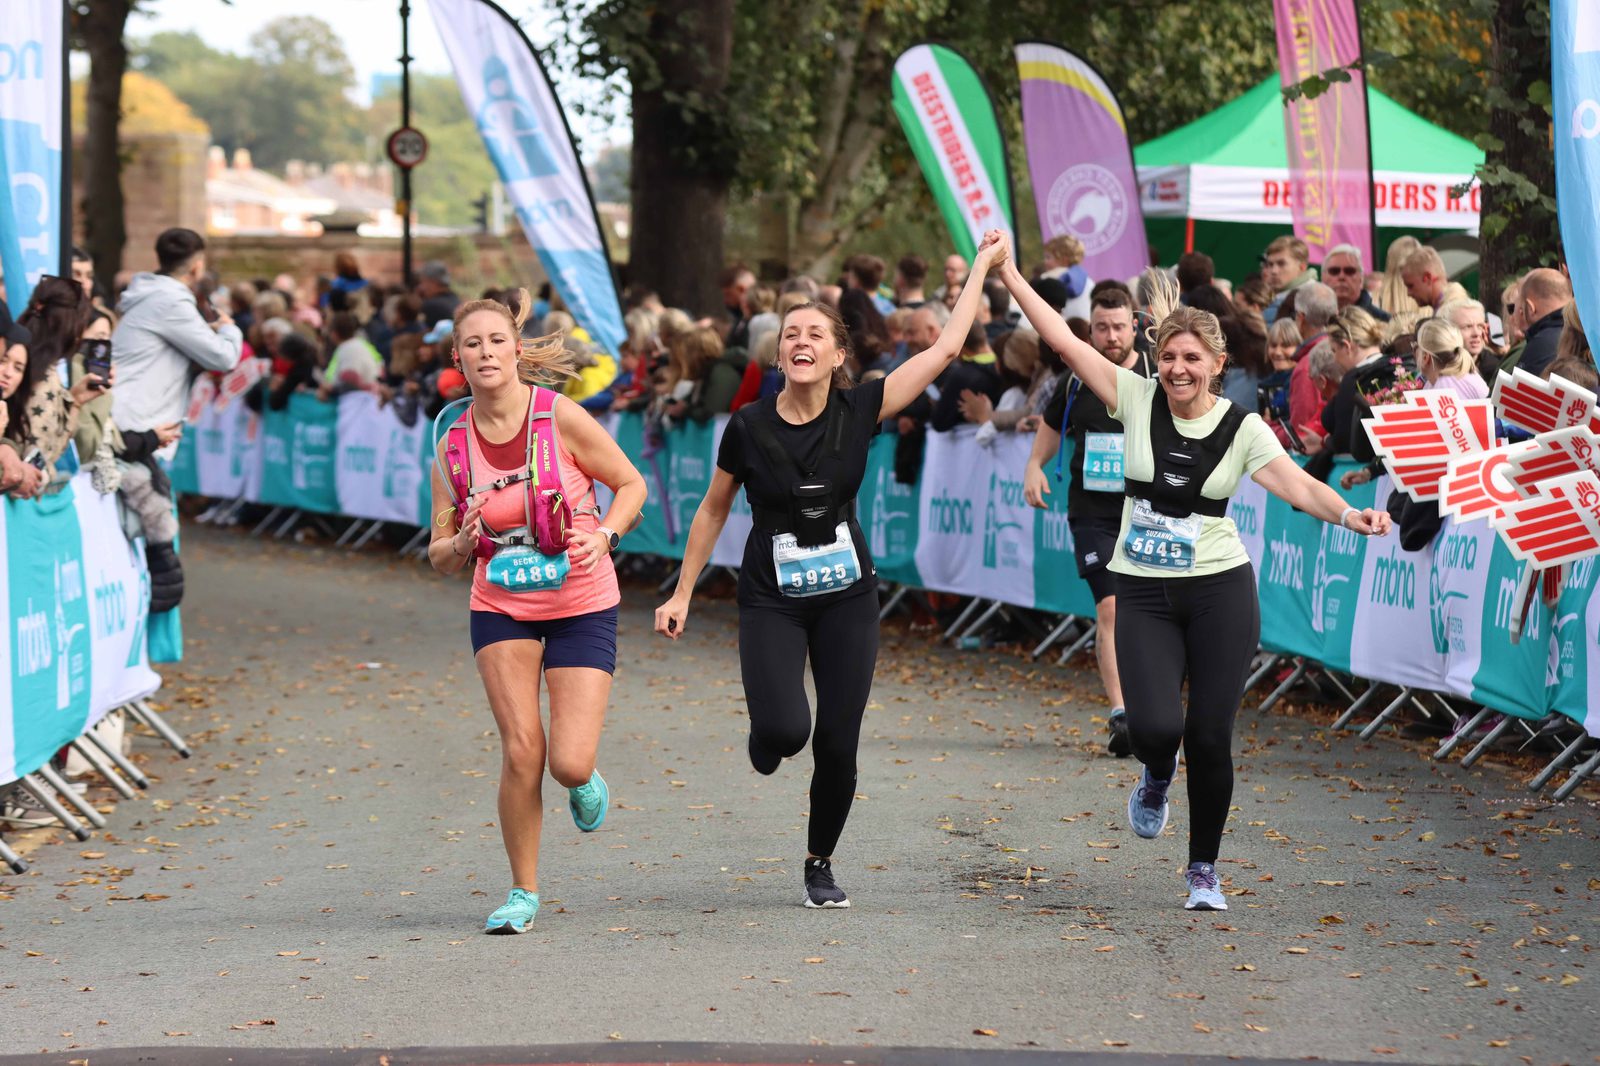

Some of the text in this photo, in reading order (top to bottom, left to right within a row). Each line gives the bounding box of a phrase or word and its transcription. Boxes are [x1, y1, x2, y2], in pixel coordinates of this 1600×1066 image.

[912, 72, 976, 189] DEESTRIDERS
[1447, 417, 1471, 453] HIGH
[1145, 529, 1174, 541] SUZANNE
[1132, 537, 1182, 558] 5645
[513, 556, 540, 566] BECKY
[501, 563, 557, 585] 1486
[791, 563, 847, 588] 5925
[1370, 545, 1415, 610] mbna
